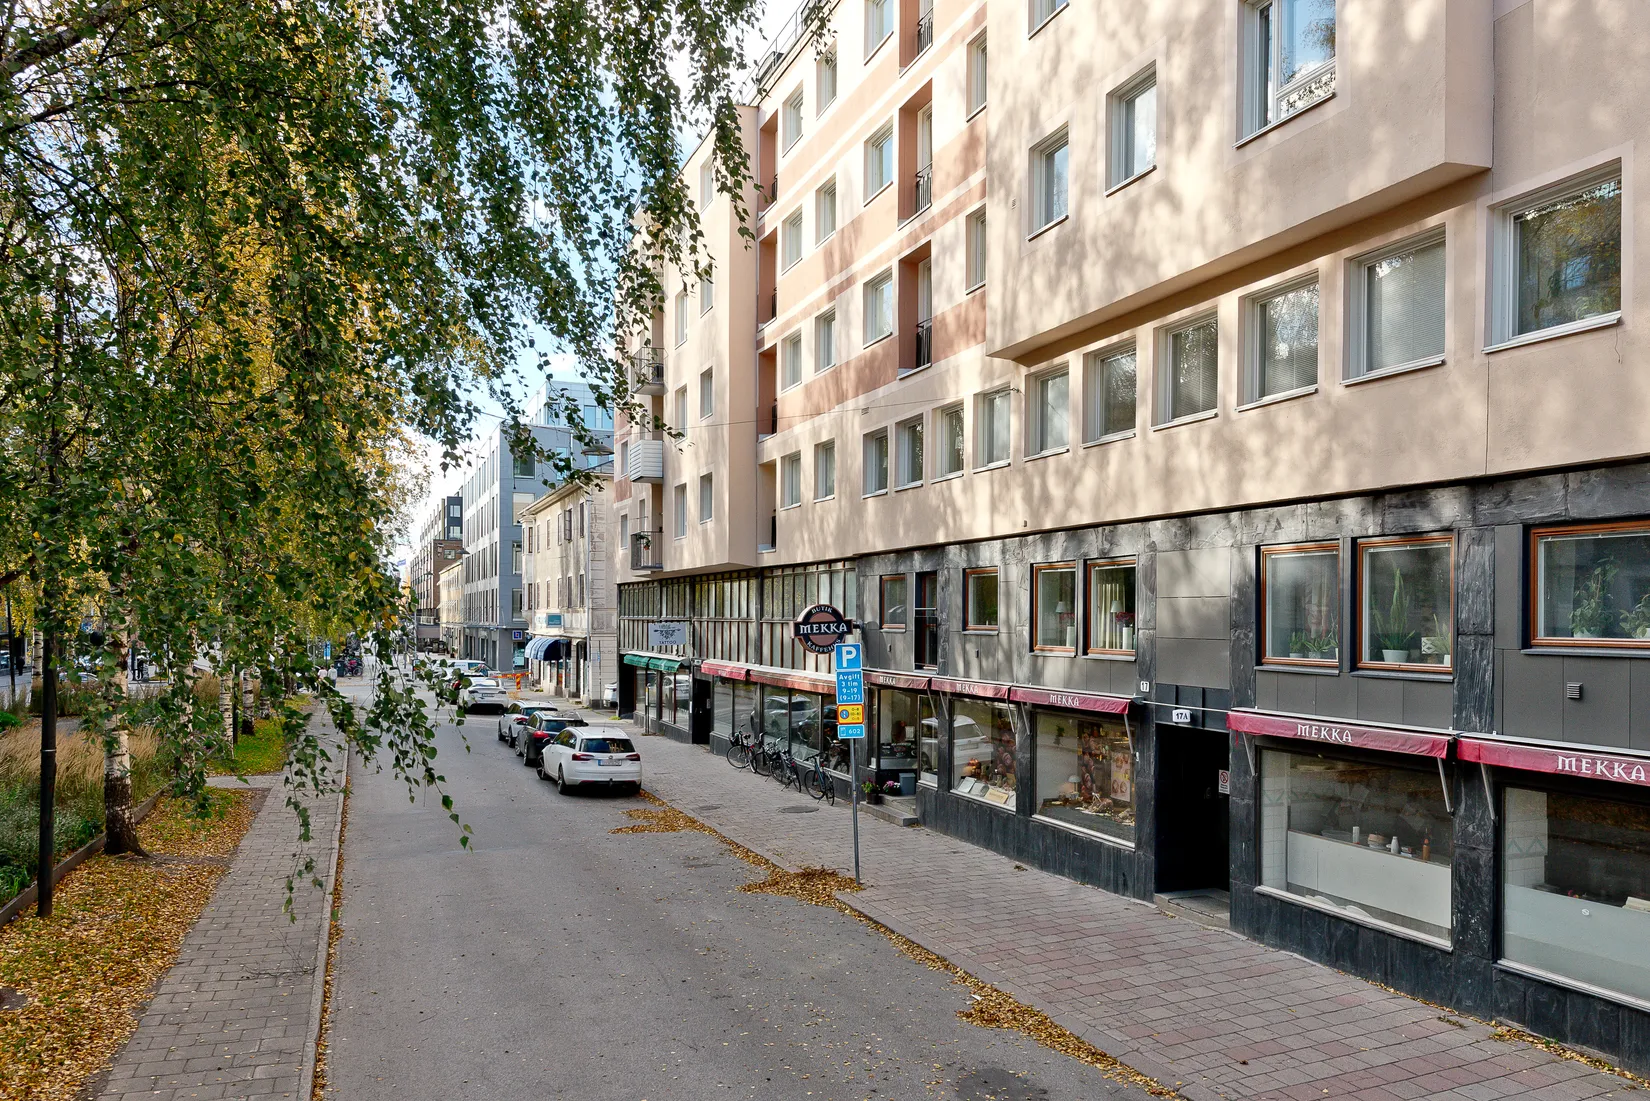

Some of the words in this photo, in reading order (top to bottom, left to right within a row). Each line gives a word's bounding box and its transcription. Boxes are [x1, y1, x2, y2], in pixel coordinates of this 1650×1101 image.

[812, 606, 833, 614] BUTIK
[799, 622, 848, 634] MEKKA
[842, 646, 857, 668] P
[879, 675, 897, 685] MEKKA
[956, 683, 979, 694] MEKKA
[1141, 682, 1148, 690] 17
[1049, 693, 1080, 707] MEKKA
[1176, 712, 1189, 720] 17A
[1297, 723, 1353, 744] MEKKA
[1556, 755, 1647, 782] MEKKA
